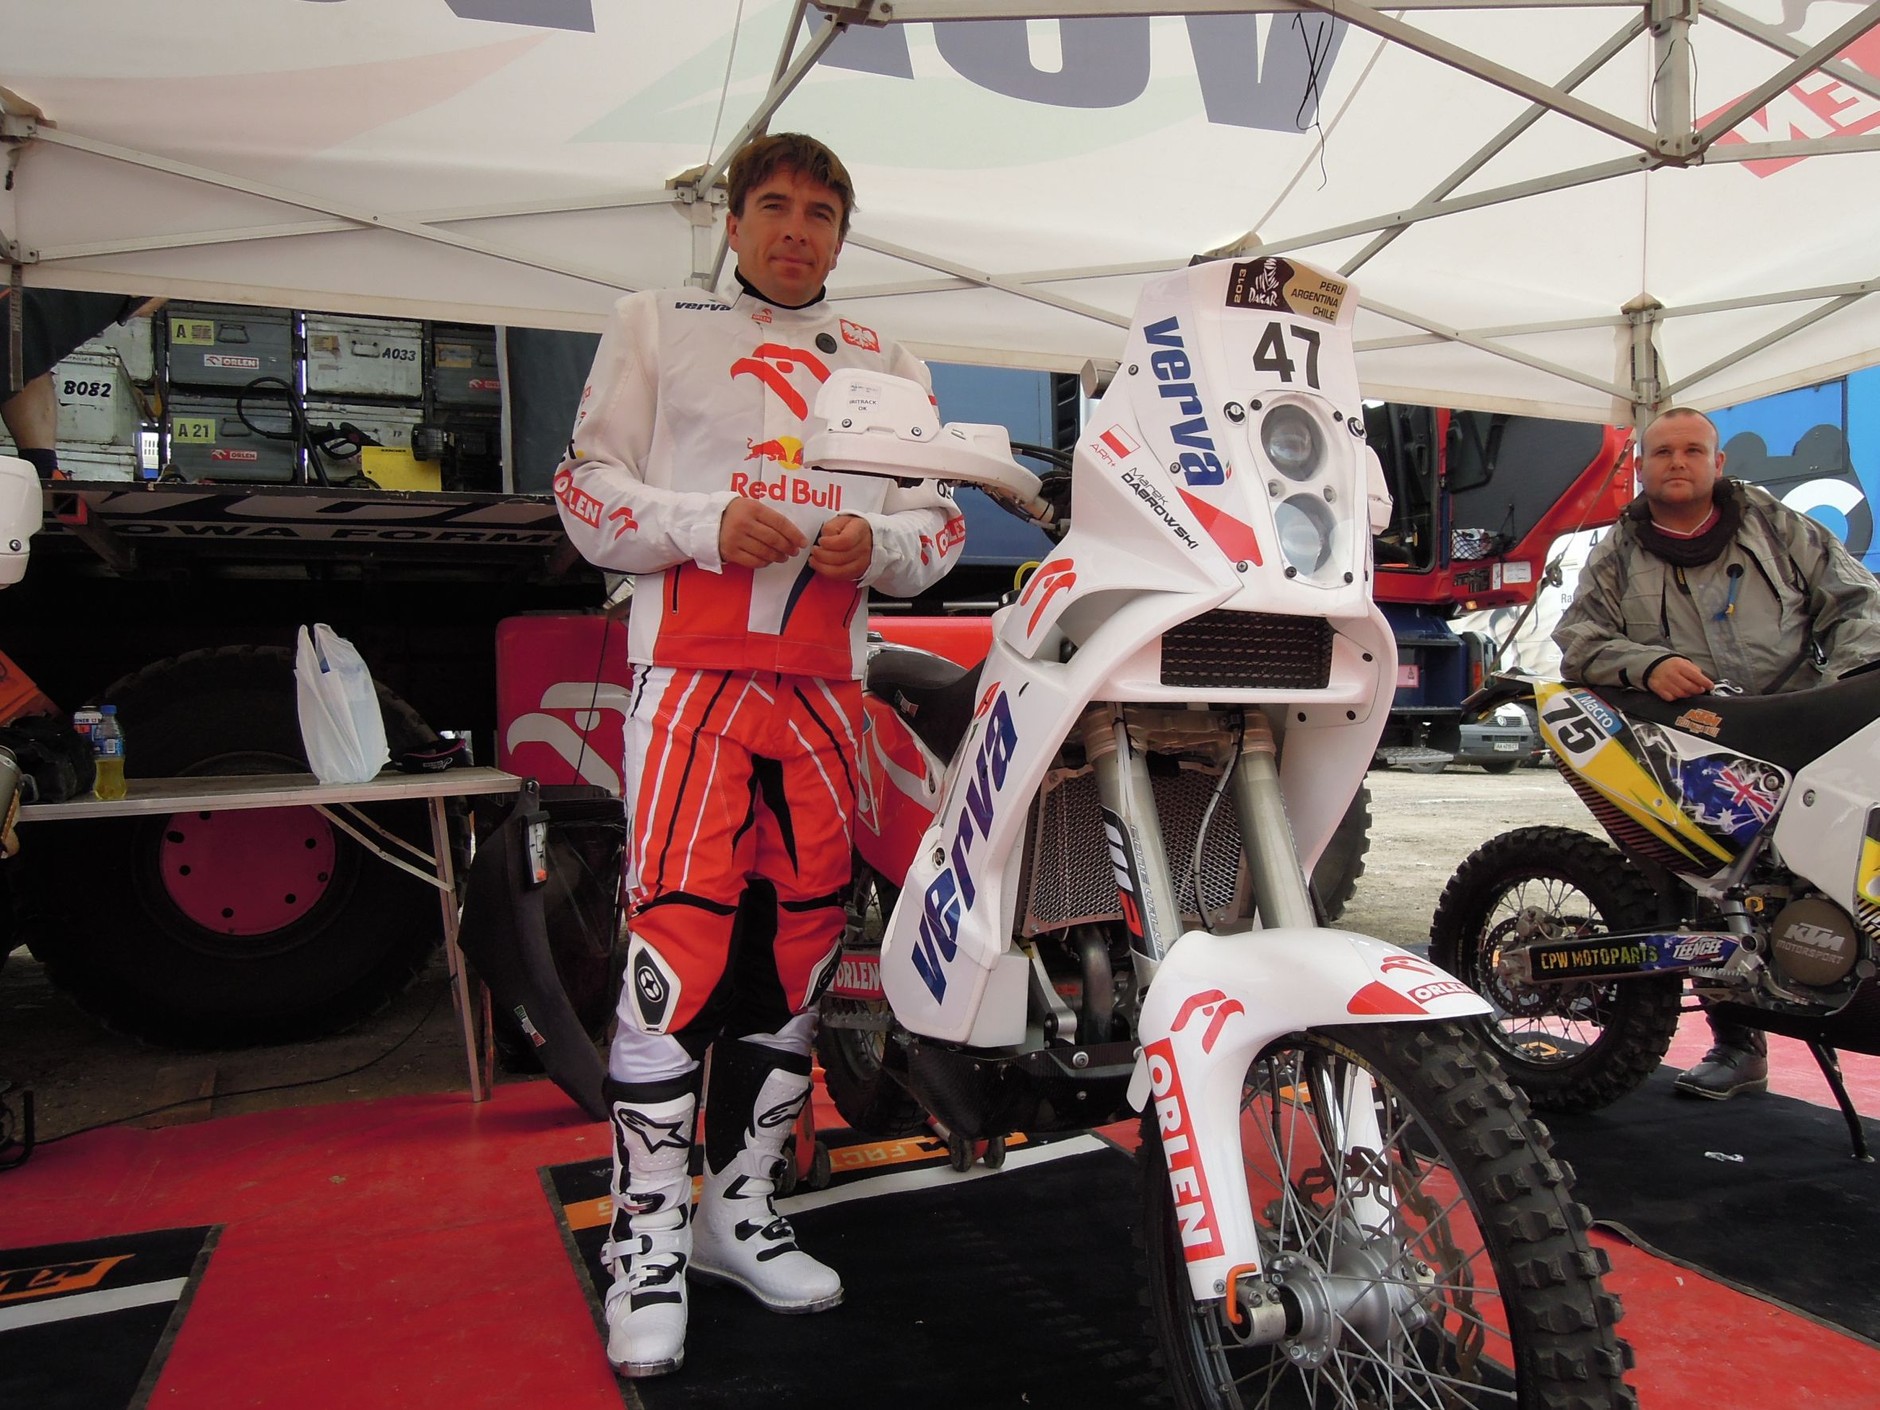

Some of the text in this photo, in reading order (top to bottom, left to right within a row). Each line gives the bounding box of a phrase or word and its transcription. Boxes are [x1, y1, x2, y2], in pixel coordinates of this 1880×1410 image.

[1233, 268, 1247, 304] 2013
[1248, 286, 1280, 307] DAKAR
[1290, 288, 1339, 308] ARGENTINA
[1319, 281, 1345, 296] PERU
[675, 301, 731, 311] verva
[1312, 305, 1336, 321] CHILE
[176, 325, 187, 339] A
[222, 357, 257, 368] ORLEN
[382, 347, 417, 362] A033
[1252, 321, 1322, 391] 47
[63, 380, 112, 398] B082
[1143, 316, 1226, 487] verva
[178, 423, 210, 438] A 21
[231, 451, 256, 460] ORLEN
[554, 474, 600, 525] OLEN
[730, 472, 843, 511] Red Bull
[1128, 467, 1169, 507] Marek
[330, 528, 564, 544] FORM
[1578, 695, 1614, 730] Macro
[1542, 697, 1607, 754] 75
[911, 690, 1018, 1006] verva
[1784, 922, 1846, 951] KTM
[1541, 945, 1659, 969] CPW MOTOPARTS
[1775, 939, 1844, 965] MOTORSPORT
[836, 961, 880, 991] ORLEN
[829, 1144, 908, 1169] FACT
[1148, 1053, 1213, 1248] ORLEN
